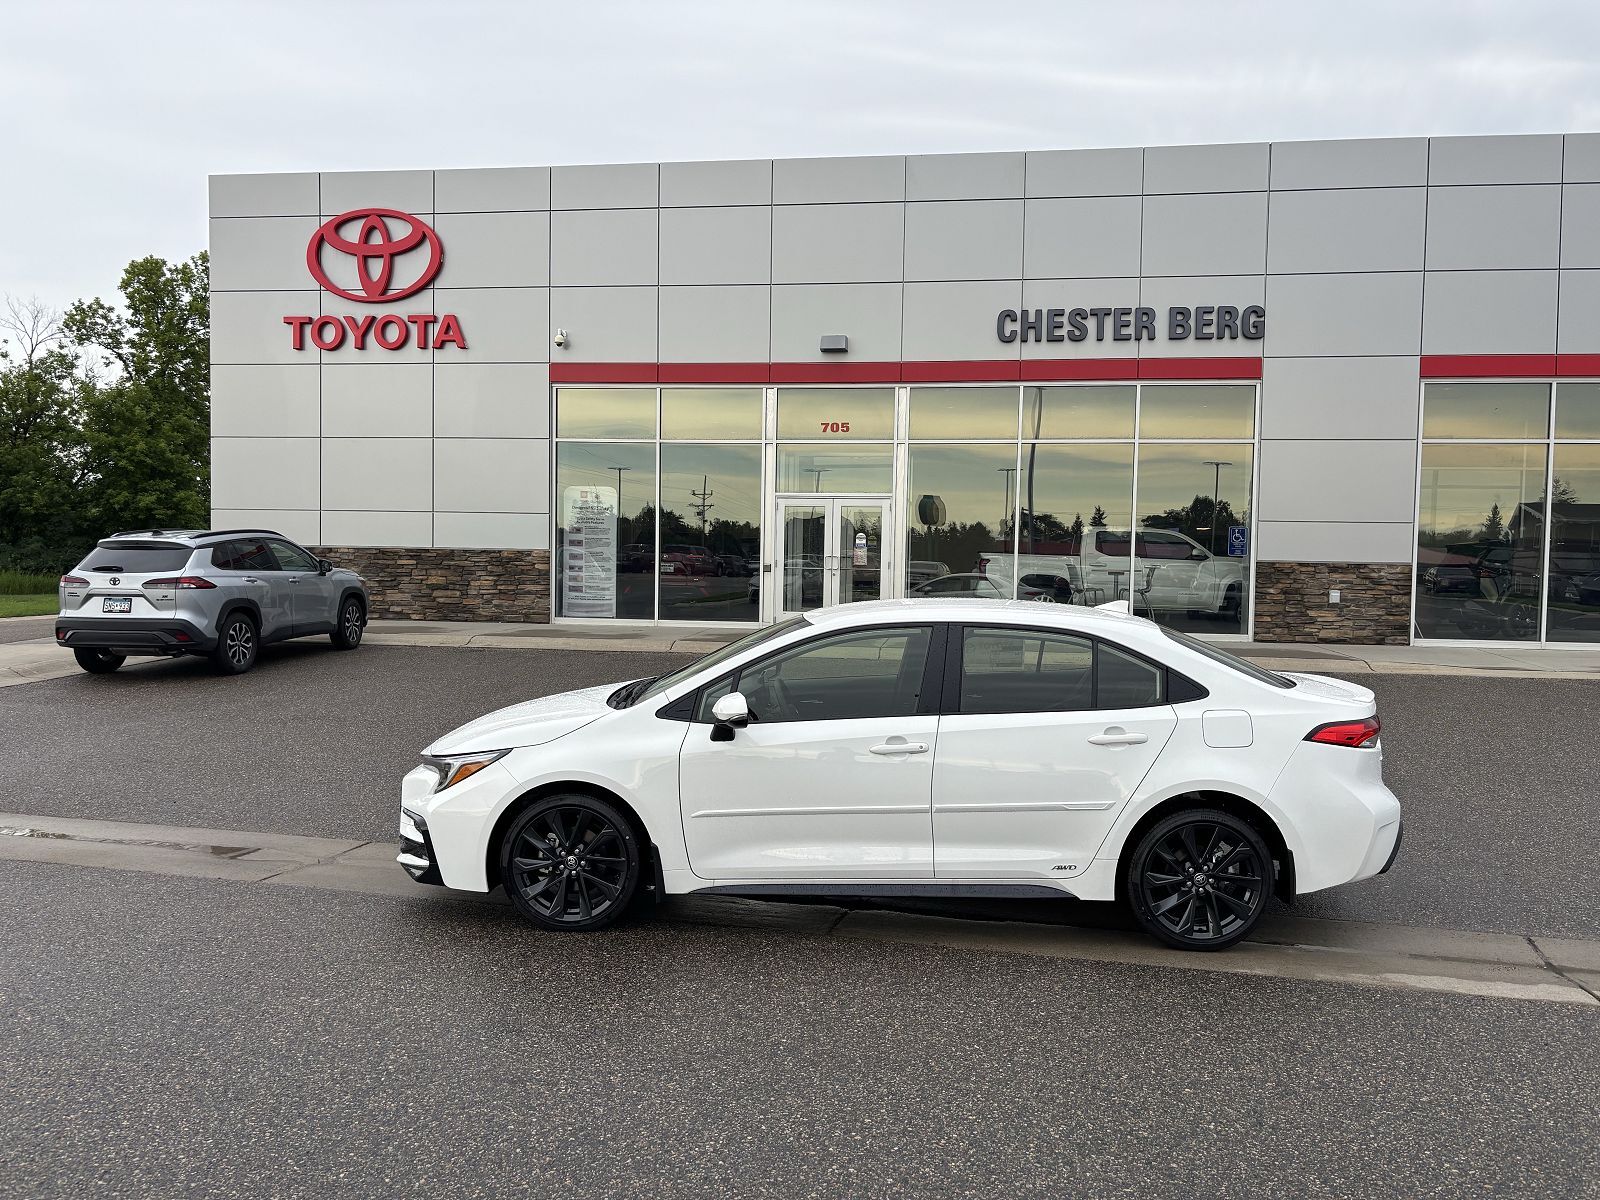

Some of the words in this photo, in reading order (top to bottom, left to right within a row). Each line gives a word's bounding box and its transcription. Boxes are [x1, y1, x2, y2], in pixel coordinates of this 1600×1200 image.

[283, 314, 468, 350] TOYOTA
[997, 307, 1157, 343] CHESTER
[1168, 305, 1266, 340] BERG
[820, 422, 850, 433] 705
